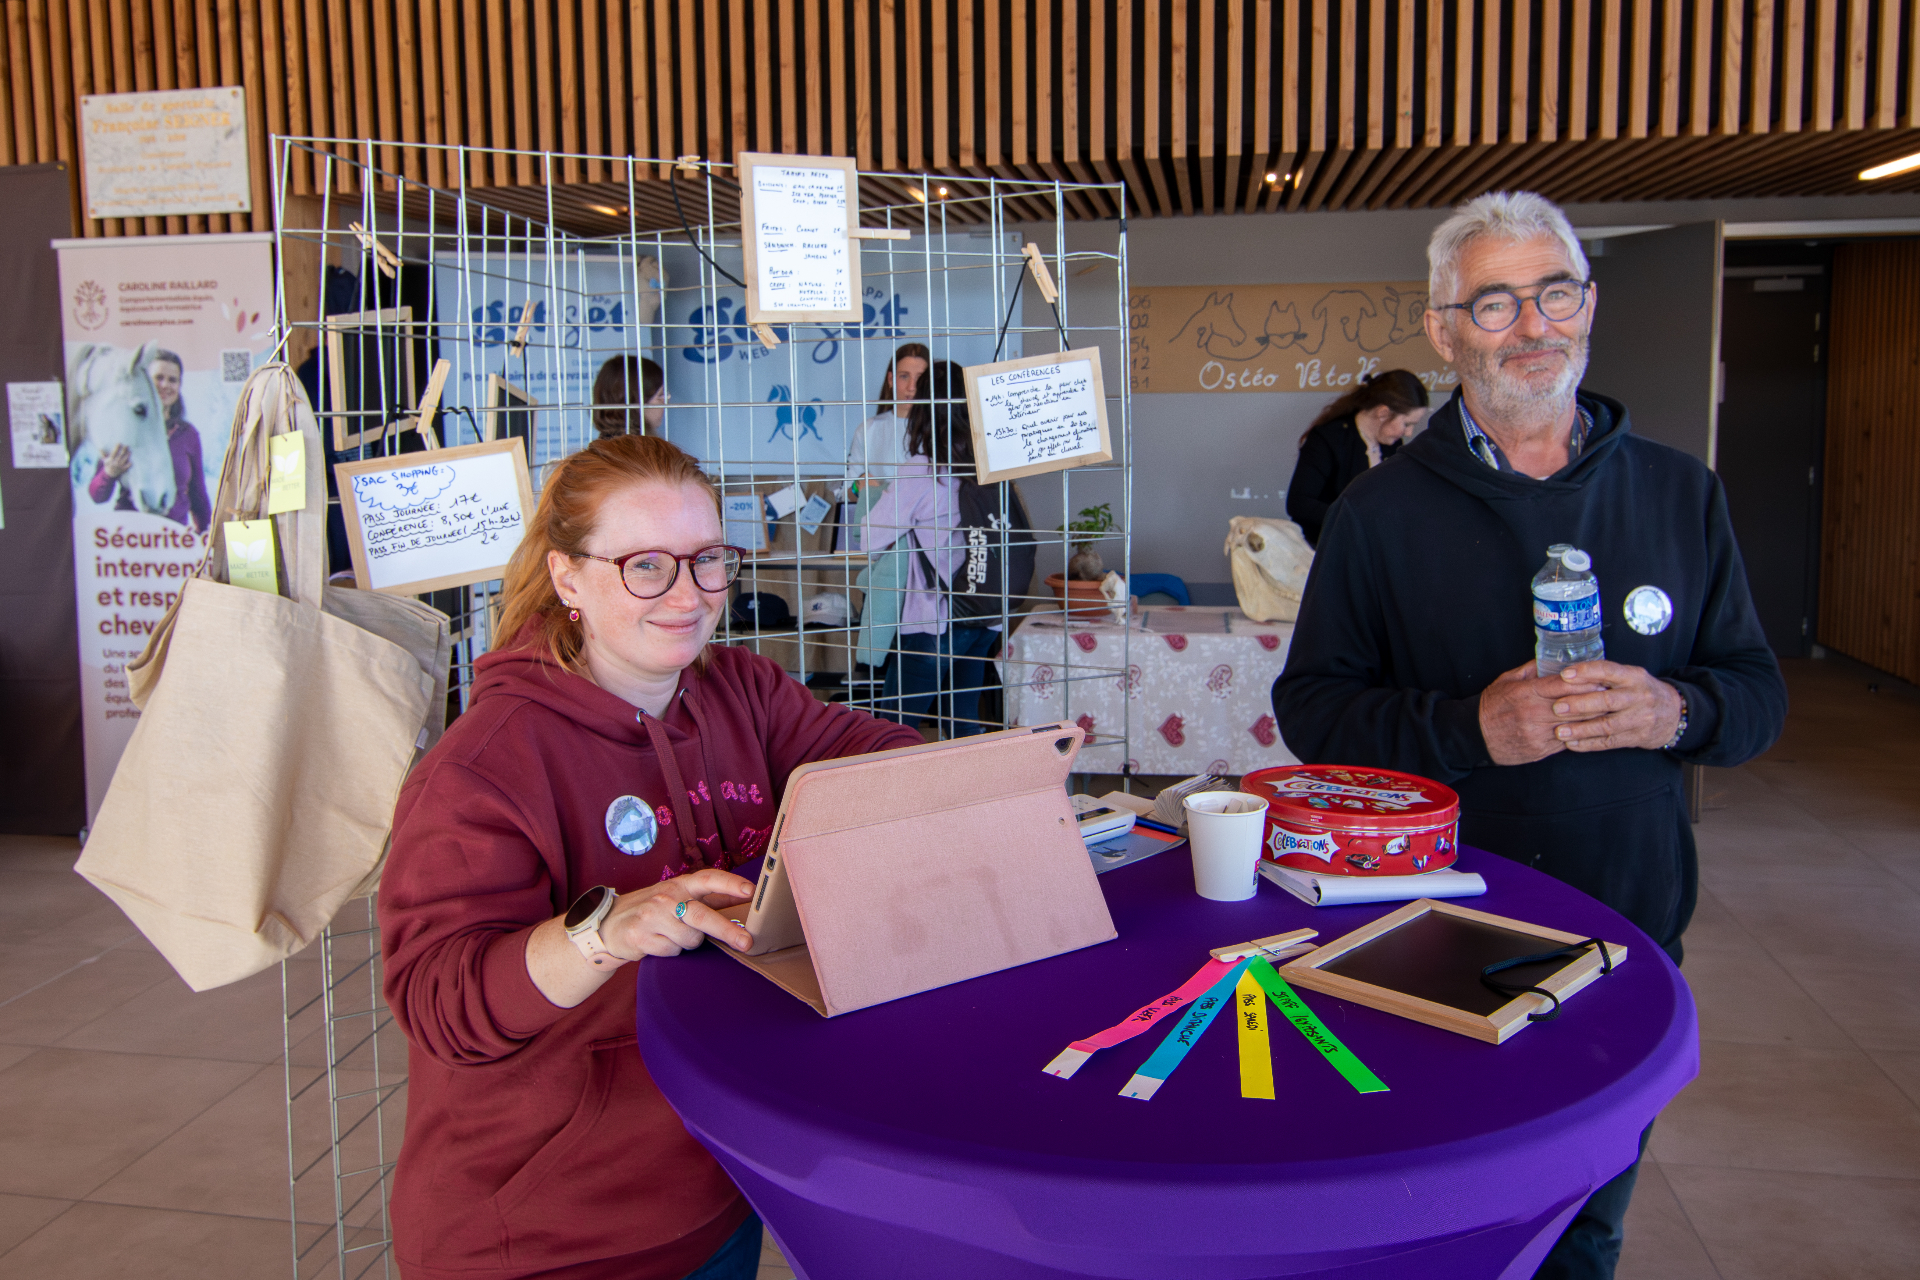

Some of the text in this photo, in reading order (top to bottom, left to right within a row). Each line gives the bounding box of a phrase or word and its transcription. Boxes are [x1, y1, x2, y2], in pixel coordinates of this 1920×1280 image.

[738, 346, 770, 361] WEB
[1132, 356, 1150, 371] 12
[991, 375, 1005, 386] LES
[1199, 360, 1279, 390] Ostéo
[1021, 420, 1038, 431] Quel
[1040, 416, 1059, 426] avenir
[361, 476, 387, 487] SAC
[396, 481, 419, 497] 3€
[362, 512, 386, 525] PASS
[449, 492, 482, 508] 17€
[95, 525, 195, 549] Sécurité
[368, 546, 388, 556] PASS
[410, 536, 422, 546] DE
[246, 570, 270, 580] BETTER
[98, 588, 123, 607] et
[1241, 993, 1257, 1008] PASS
